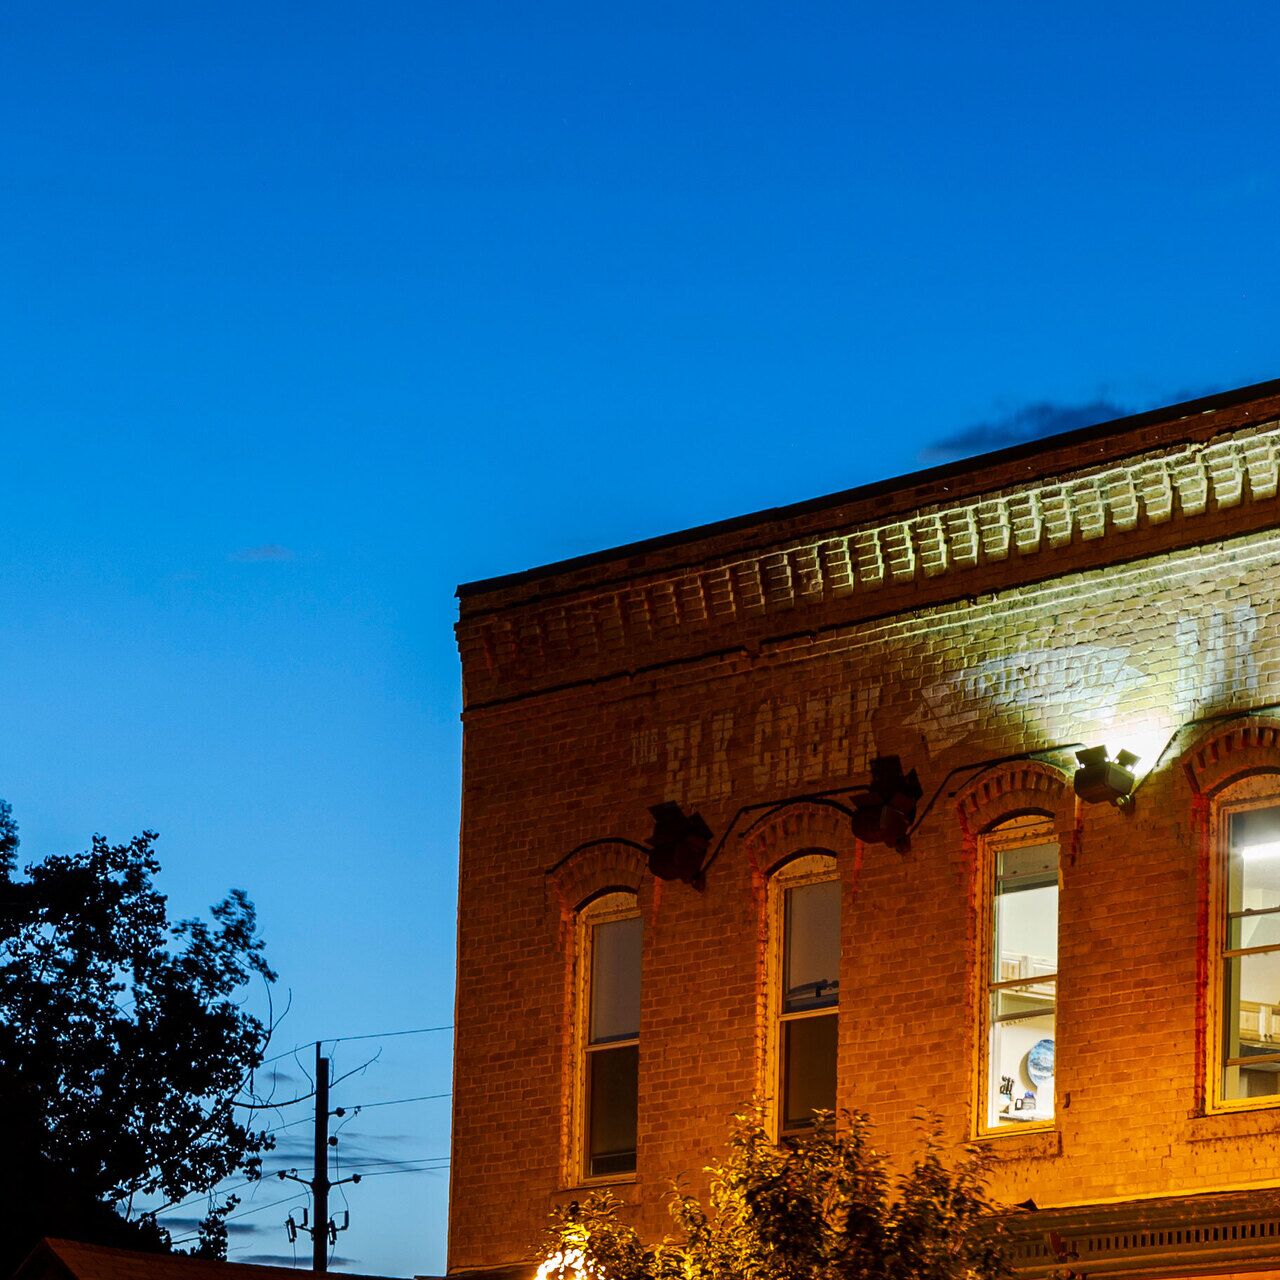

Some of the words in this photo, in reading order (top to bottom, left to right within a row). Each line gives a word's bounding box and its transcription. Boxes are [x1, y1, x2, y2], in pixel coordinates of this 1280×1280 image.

[1176, 600, 1259, 712] BAR
[663, 712, 735, 804] ELK
[752, 687, 880, 791] CREEK
